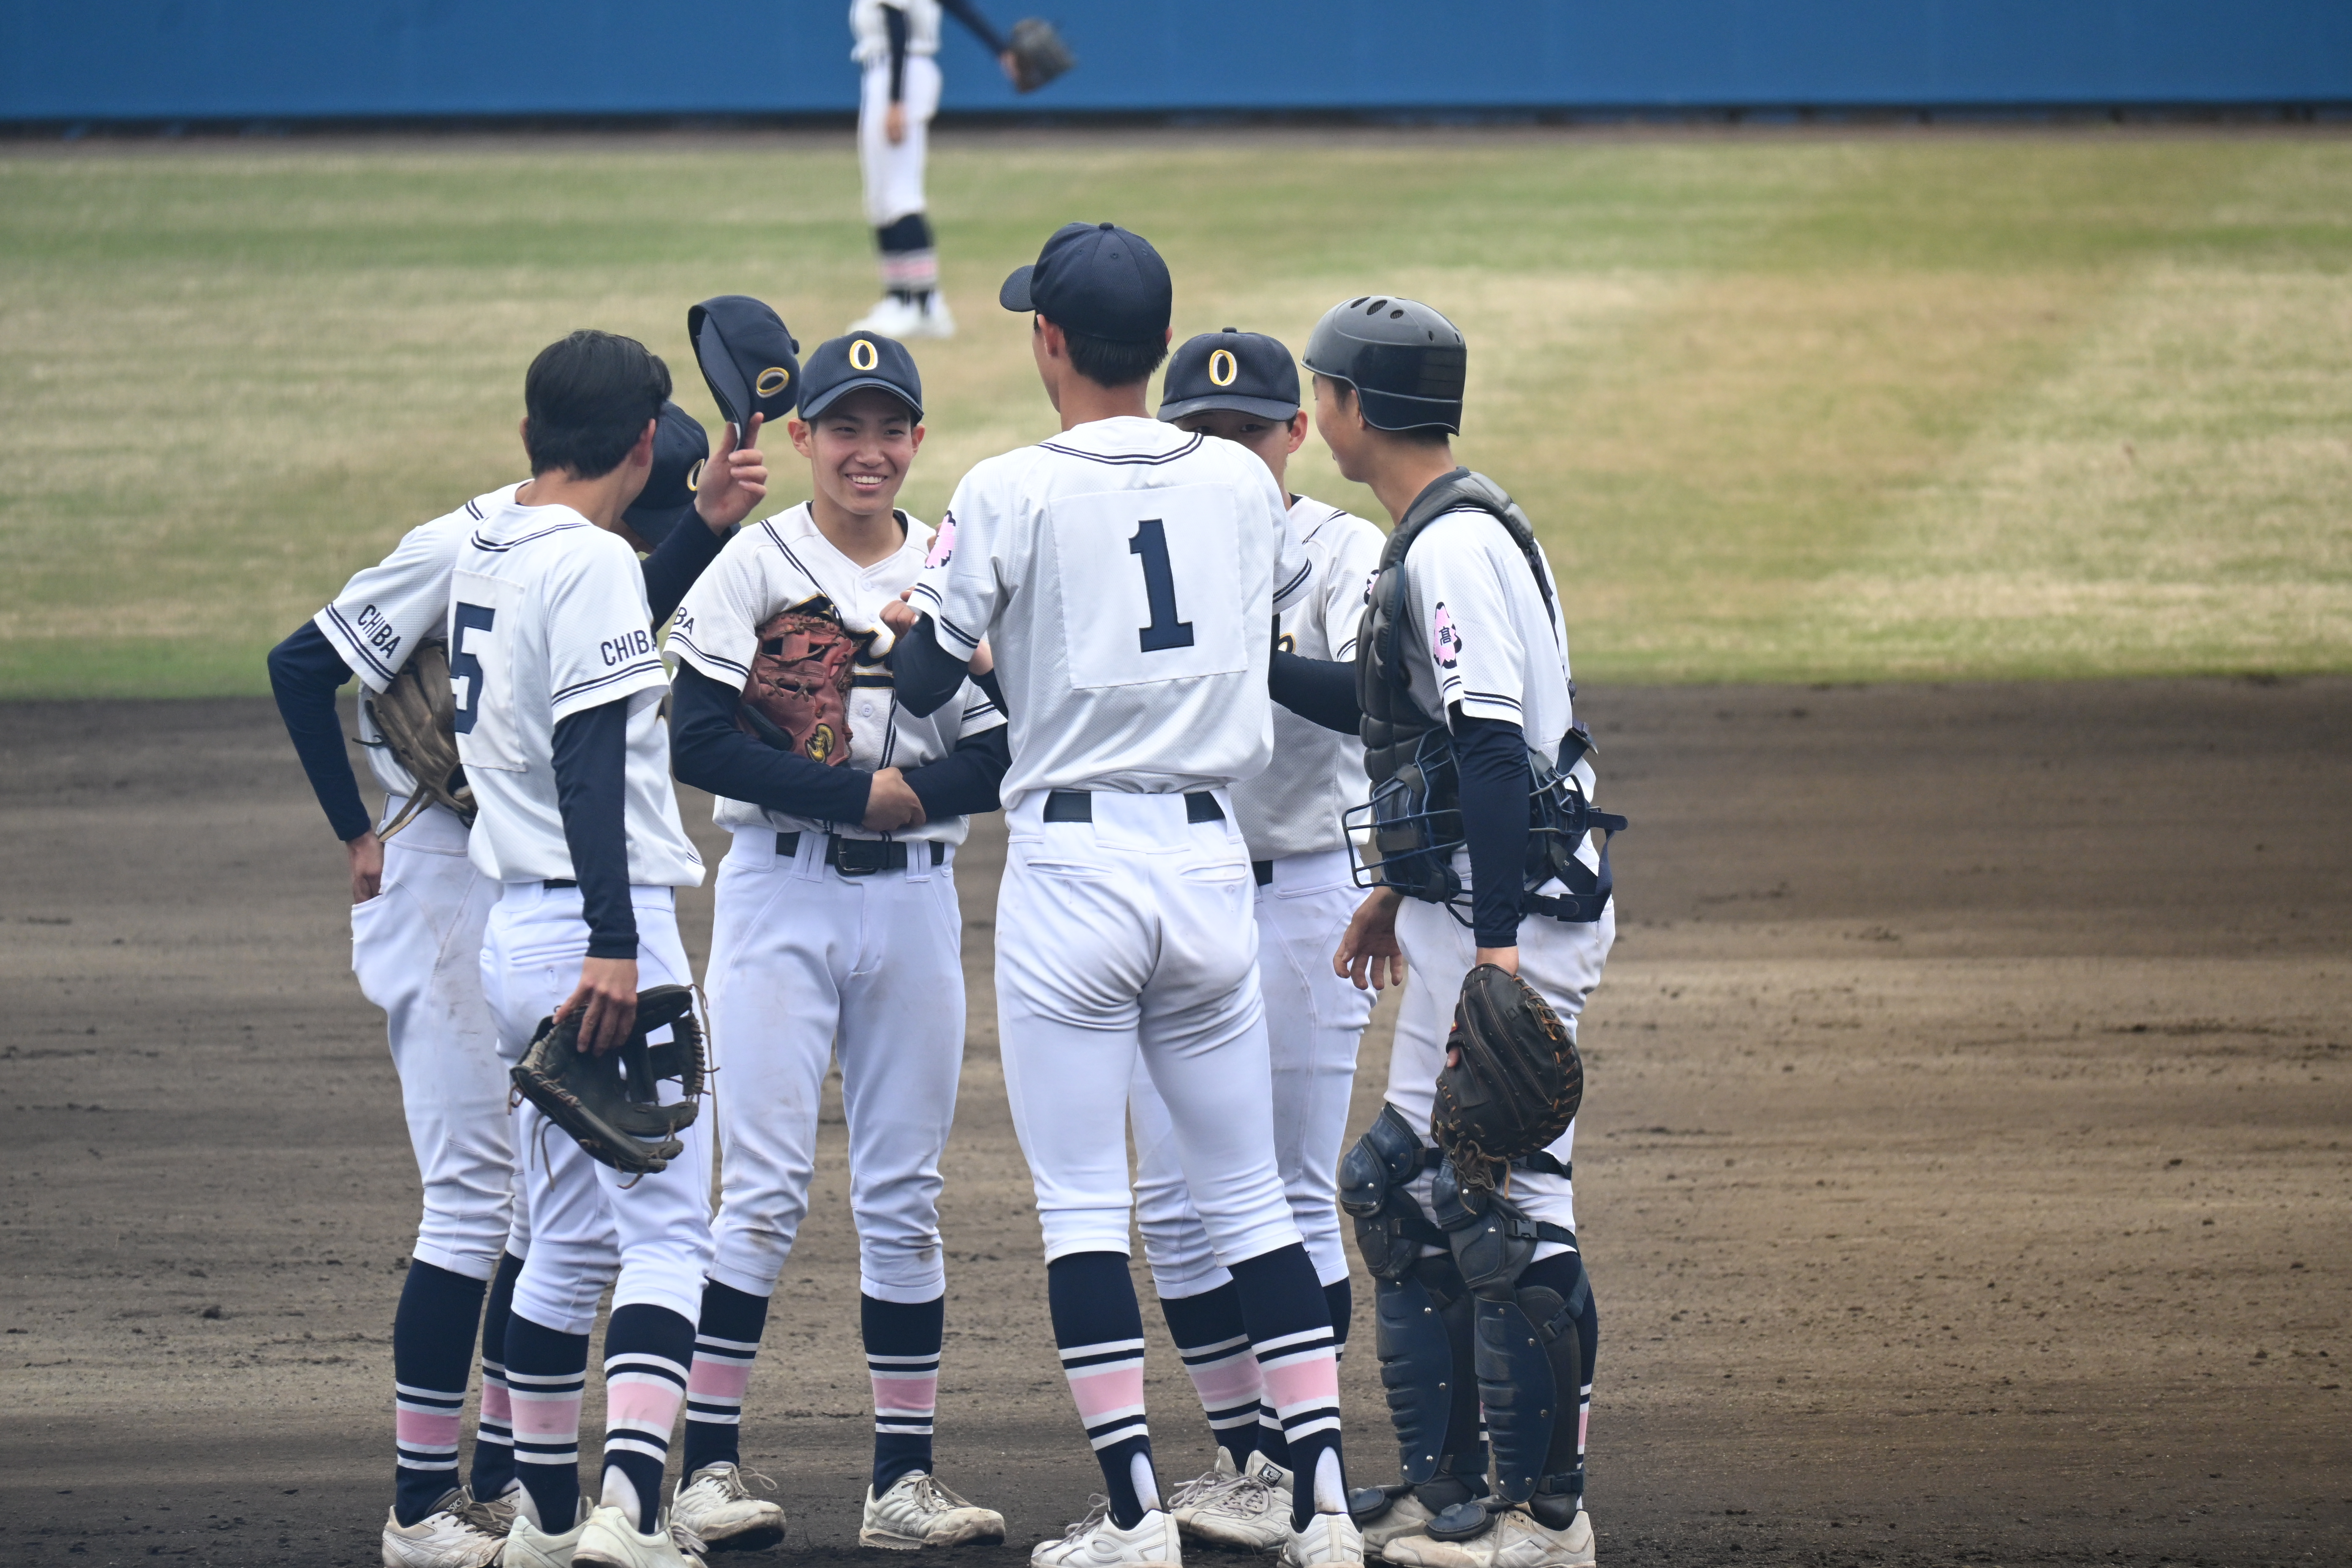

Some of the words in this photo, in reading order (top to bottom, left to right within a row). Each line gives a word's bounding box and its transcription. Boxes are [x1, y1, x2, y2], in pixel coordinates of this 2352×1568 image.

[357, 604, 401, 659] CHIBA
[1128, 518, 1195, 653] 1
[449, 601, 496, 735] 5
